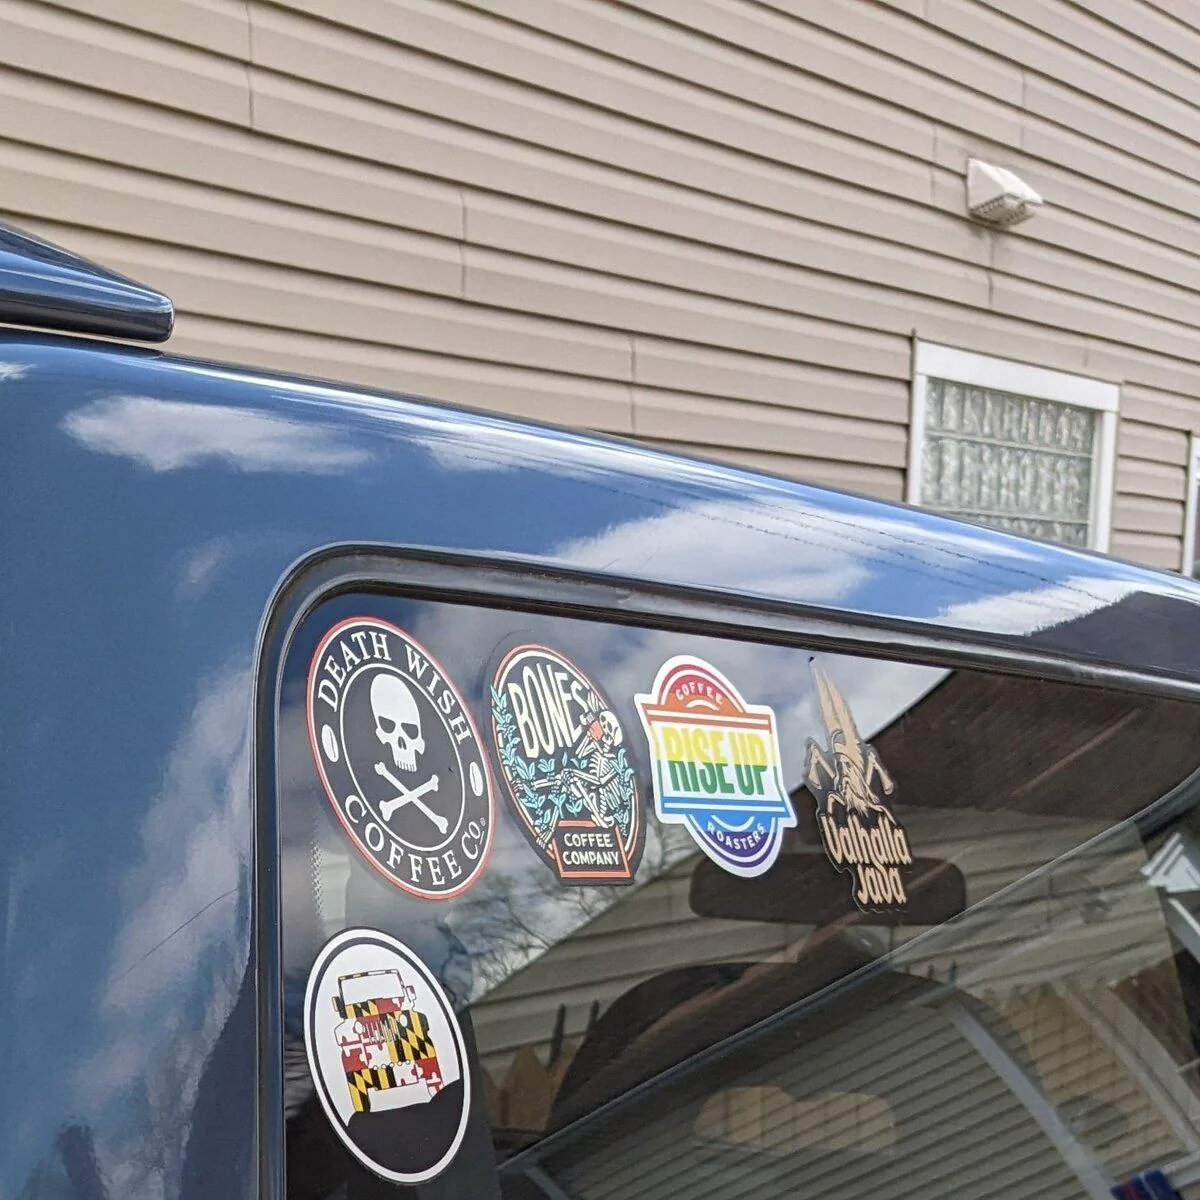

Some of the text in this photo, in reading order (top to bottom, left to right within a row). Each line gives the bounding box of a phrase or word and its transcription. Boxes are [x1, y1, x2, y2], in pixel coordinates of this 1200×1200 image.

[317, 631, 474, 746] DEATH WISH
[507, 663, 589, 758] BONES
[675, 681, 724, 706] COFFEE
[662, 726, 768, 795] RISE UP
[344, 793, 463, 887] COFFEE
[562, 850, 620, 867] COMPANY
[563, 832, 613, 849] COFFEE
[705, 821, 767, 851] ROASTERS
[819, 812, 913, 866] Valhalla
